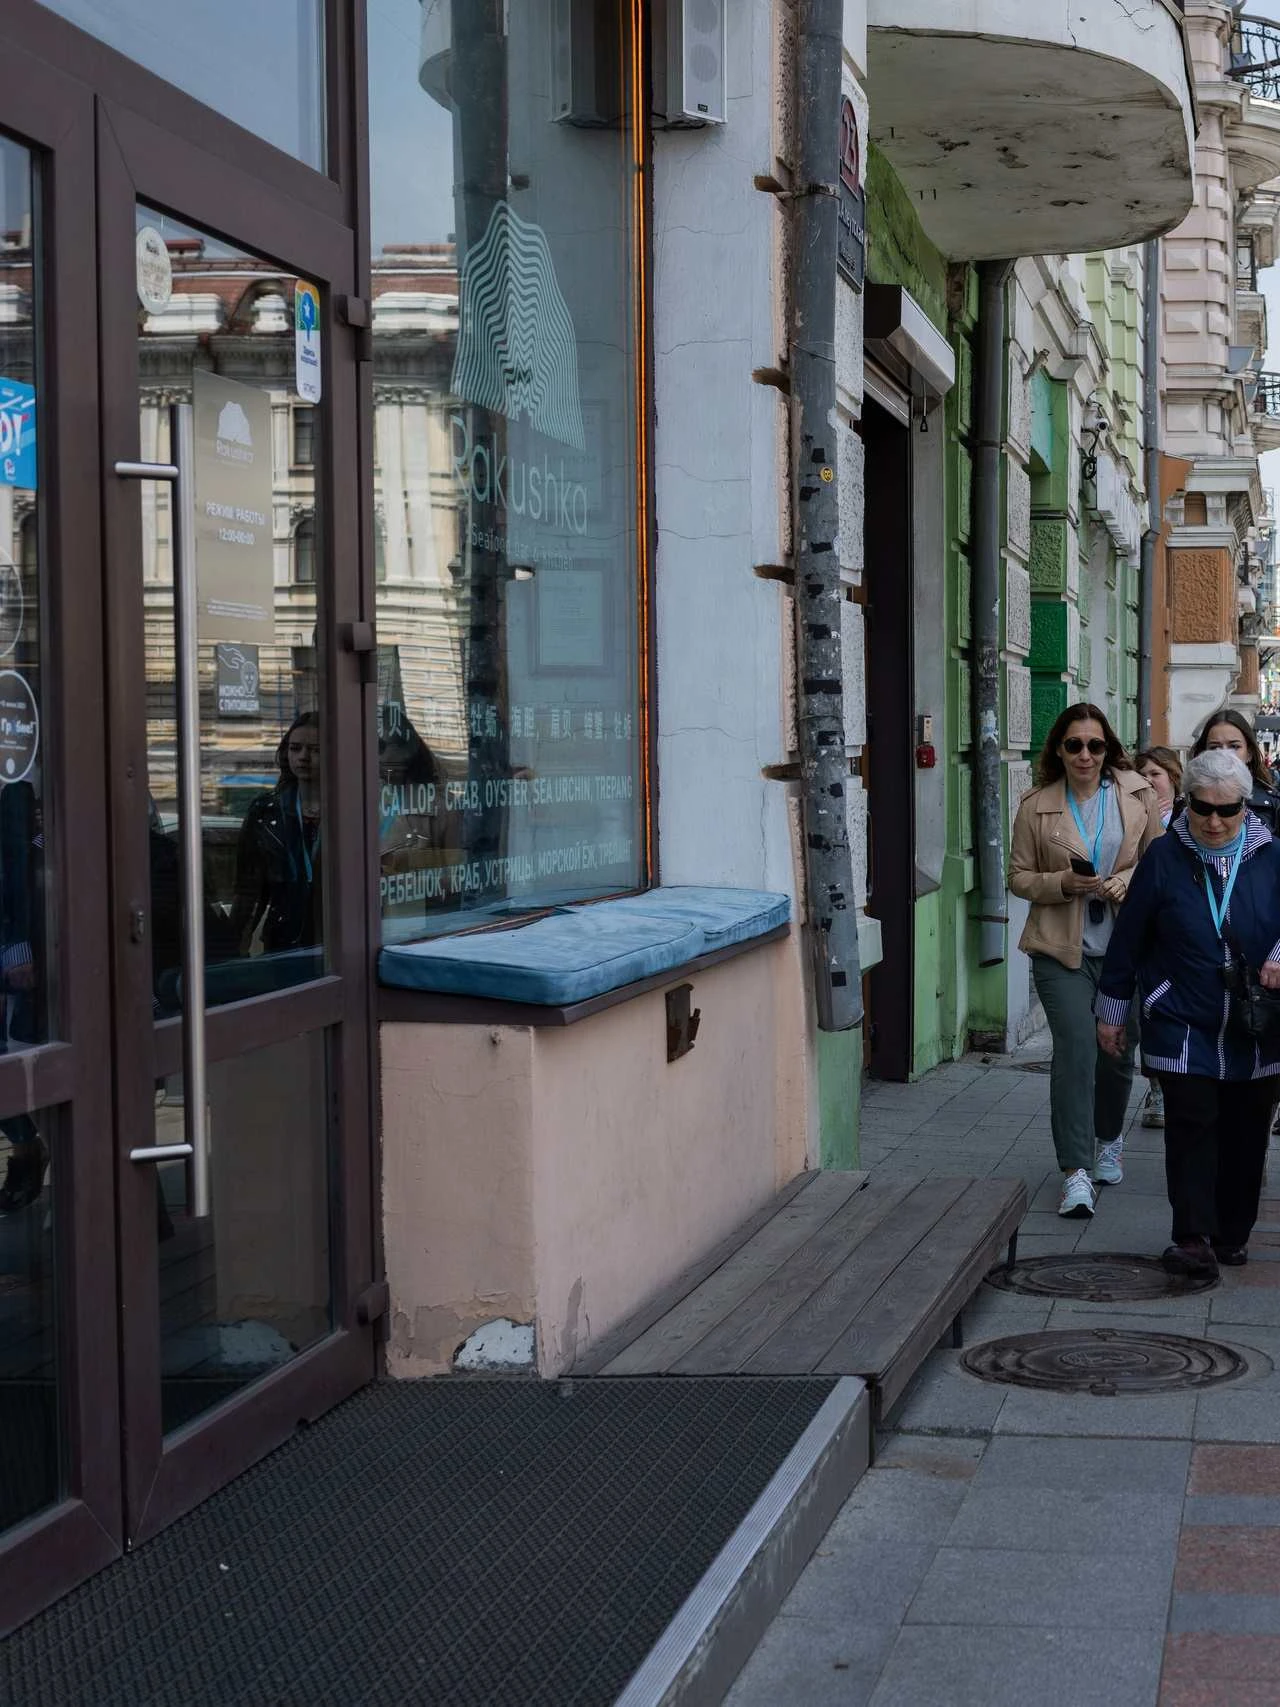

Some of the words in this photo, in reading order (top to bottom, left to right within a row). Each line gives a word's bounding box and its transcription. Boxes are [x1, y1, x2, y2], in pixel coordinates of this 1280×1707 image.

[450, 414, 588, 537] Rakushka
[236, 508, 265, 527] РАБОТЫ
[379, 783, 438, 817] CALLOP,
[445, 781, 483, 814] CRAB,
[485, 777, 532, 812] OYSTER,
[533, 777, 553, 805] SEA
[555, 776, 593, 804] URCHIN,
[595, 775, 632, 801] TREPANG
[450, 862, 483, 893] КРАБ,
[484, 854, 536, 887] УСТРИЦЫ,
[538, 841, 581, 877] МОРСКОЙ
